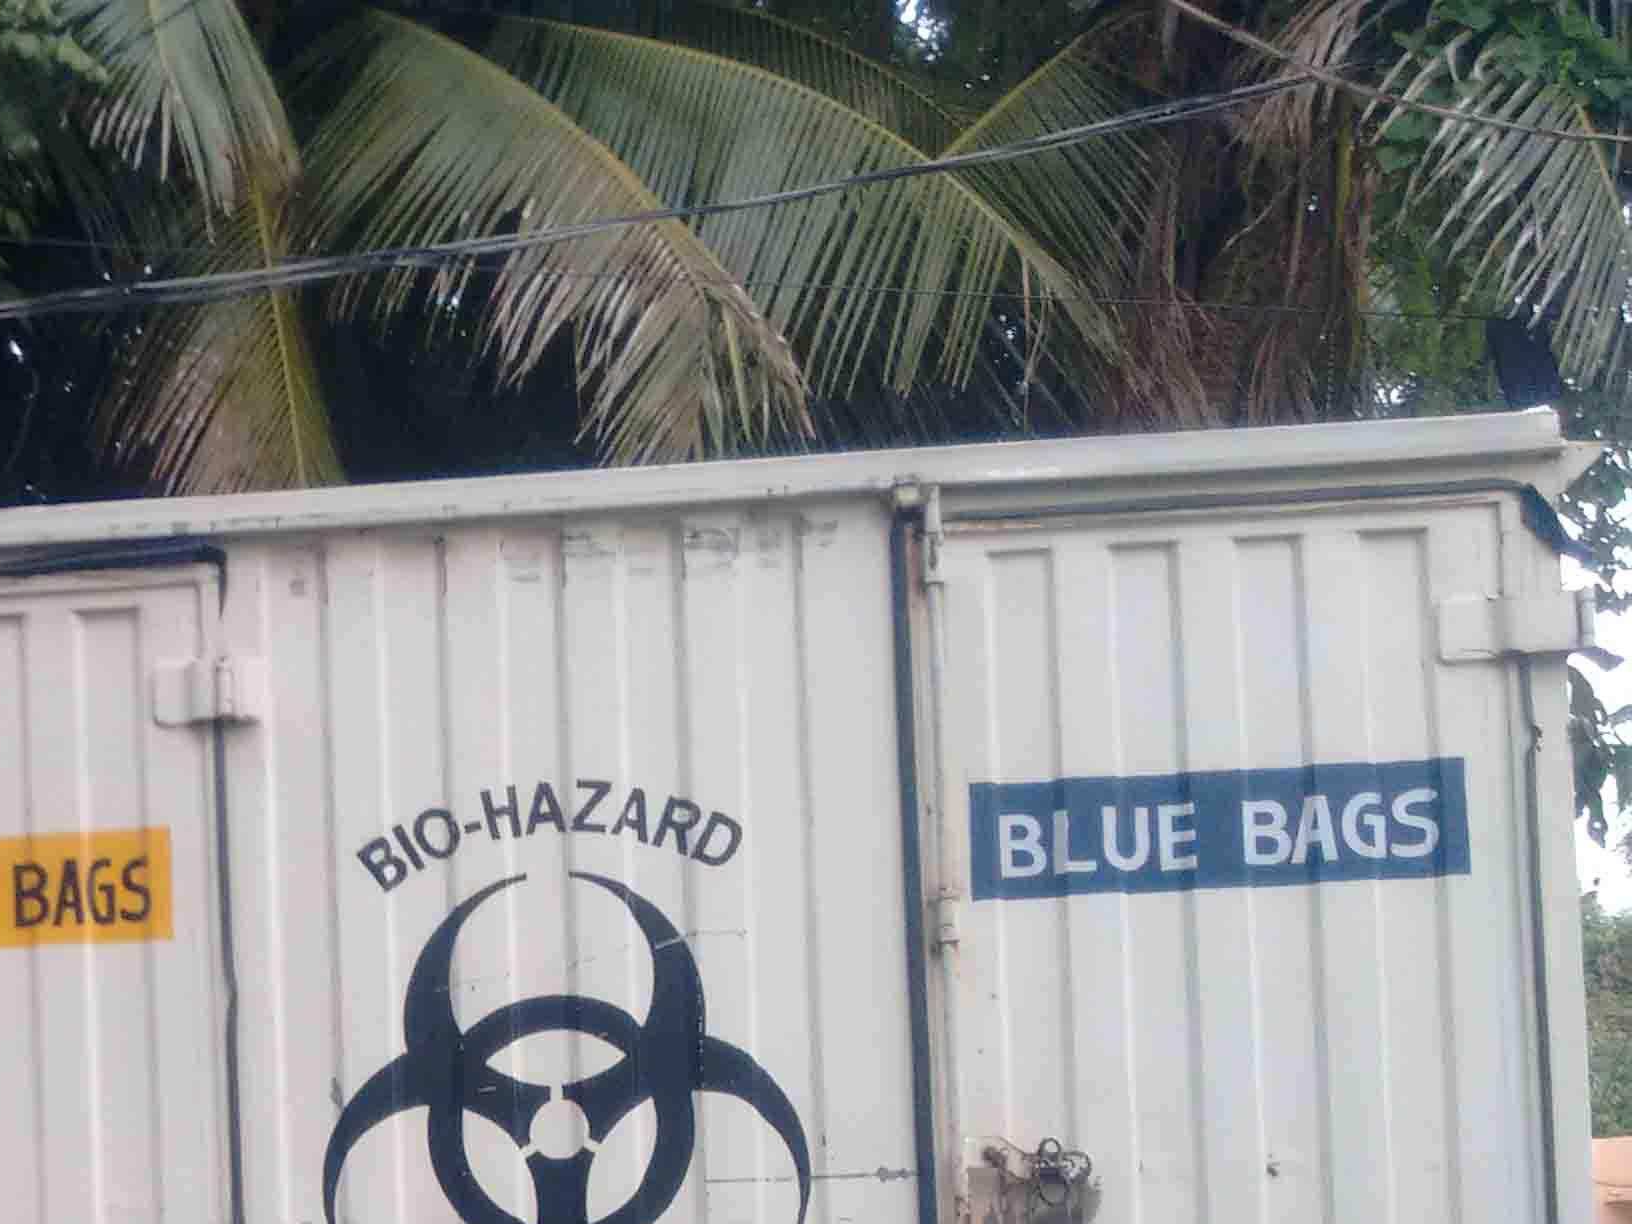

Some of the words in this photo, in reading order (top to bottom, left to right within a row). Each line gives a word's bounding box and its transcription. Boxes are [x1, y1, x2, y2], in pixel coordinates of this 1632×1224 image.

[356, 778, 744, 892] BIO-HAZARD
[998, 800, 1198, 880] BLUE
[1241, 787, 1440, 866] BAGS
[13, 854, 152, 928] BAGS
